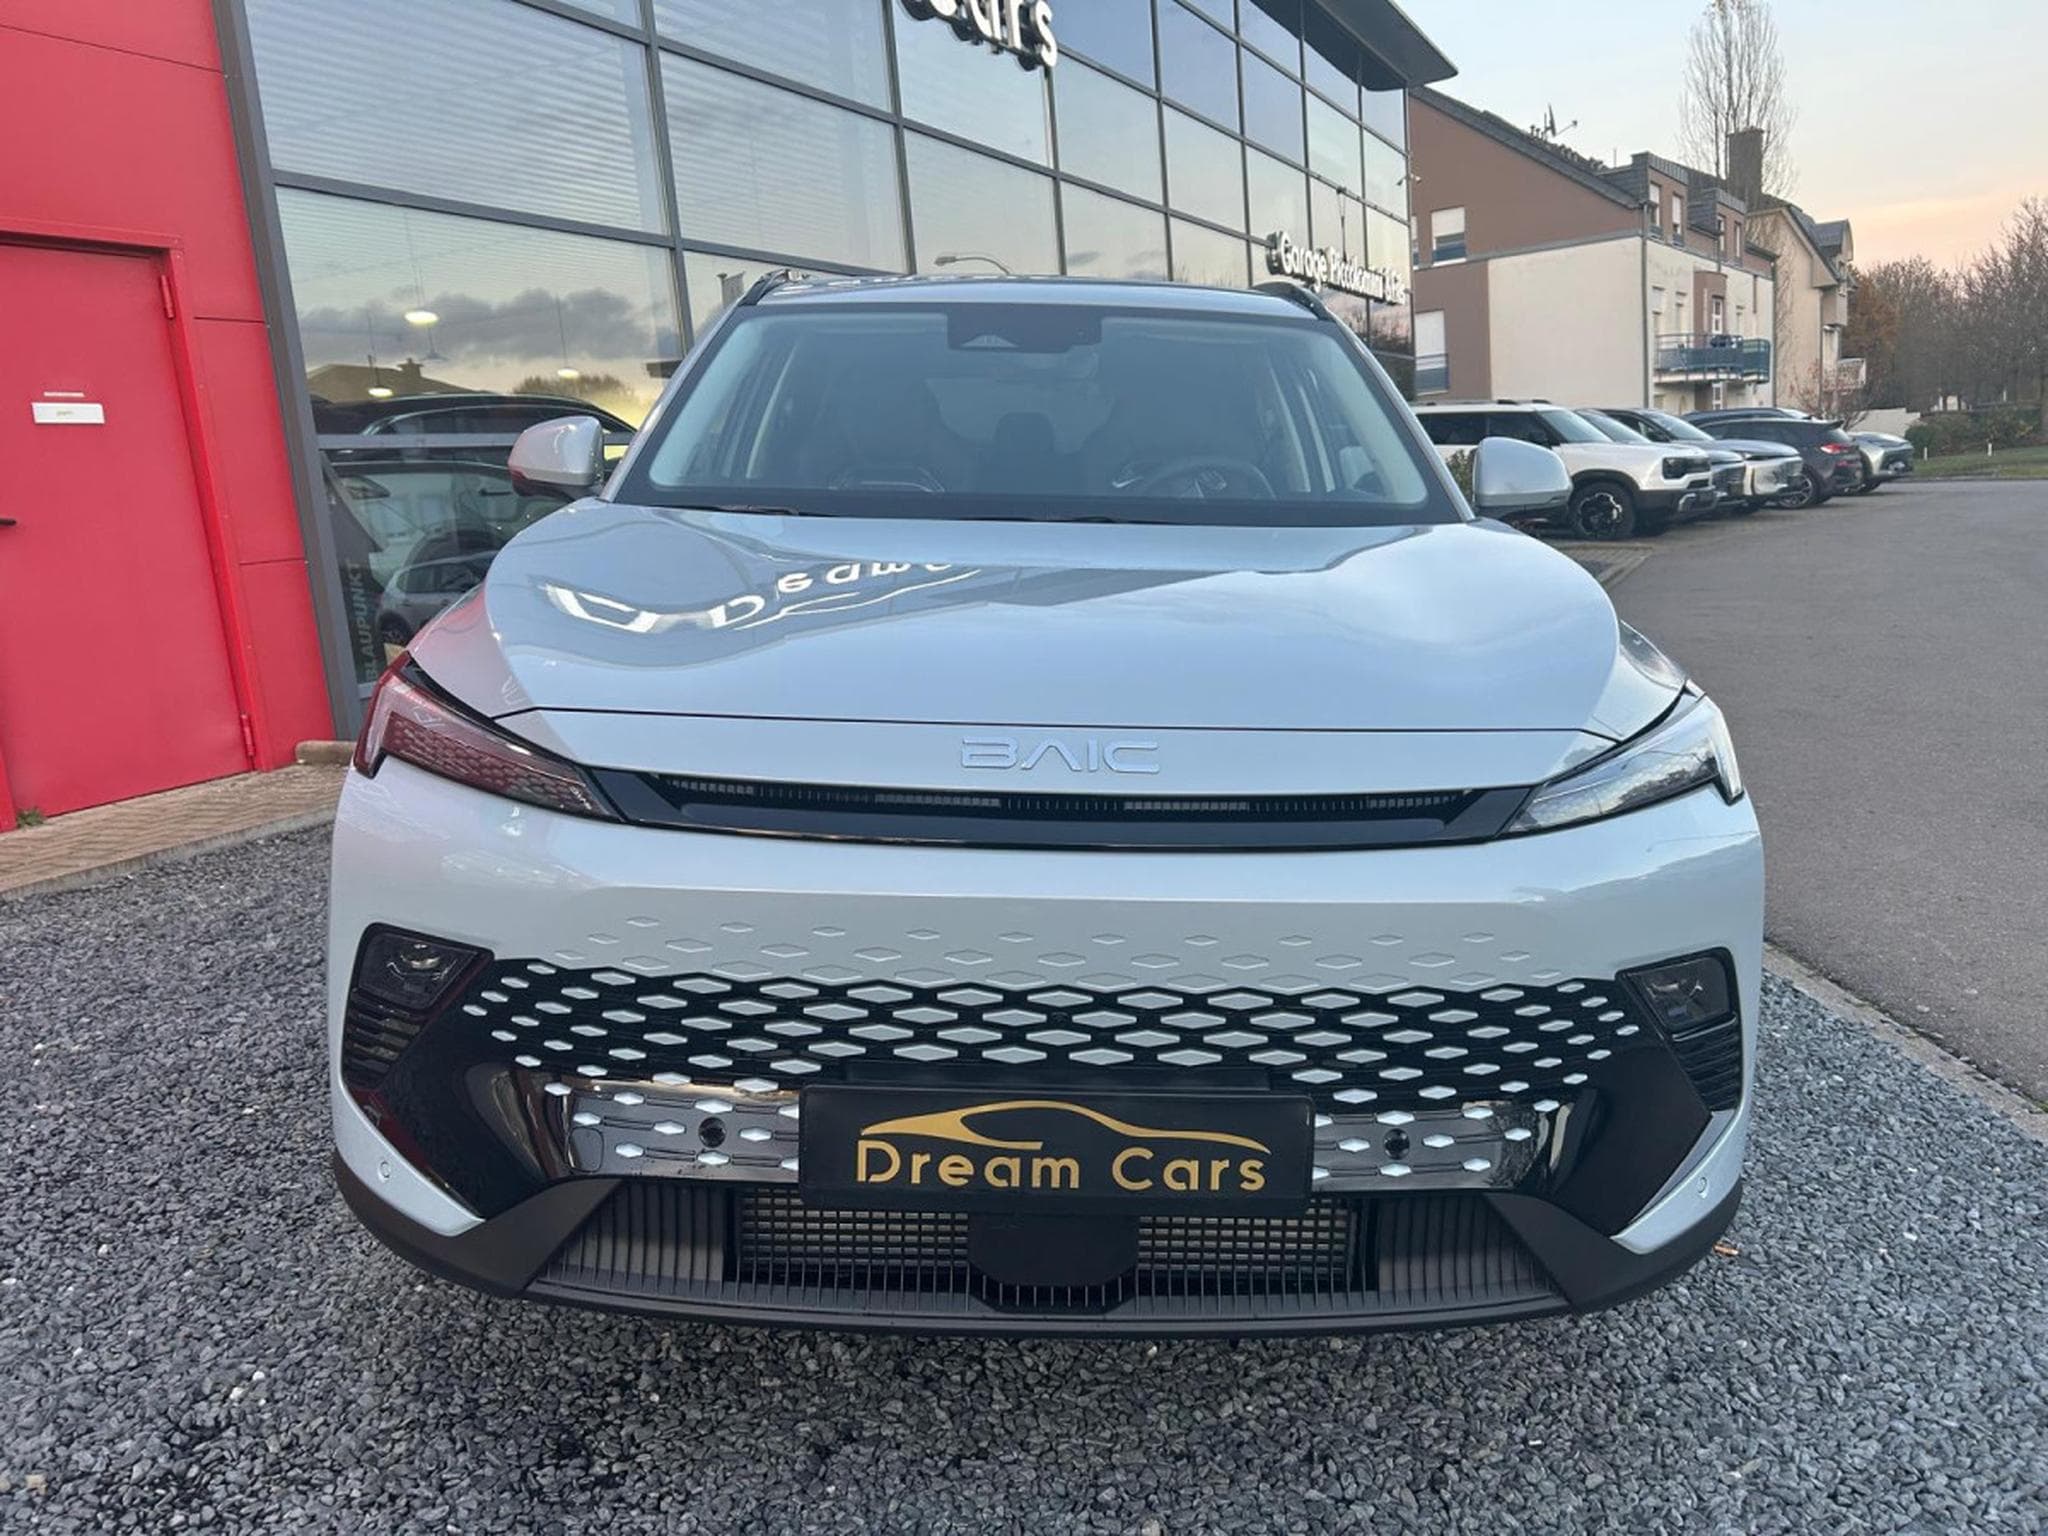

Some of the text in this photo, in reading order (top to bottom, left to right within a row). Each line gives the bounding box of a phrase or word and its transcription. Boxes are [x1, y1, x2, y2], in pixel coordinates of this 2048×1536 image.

[1281, 231, 1327, 294] Garage
[961, 735, 1160, 774] BAIC
[857, 1139, 1266, 1191] Dream Cars
